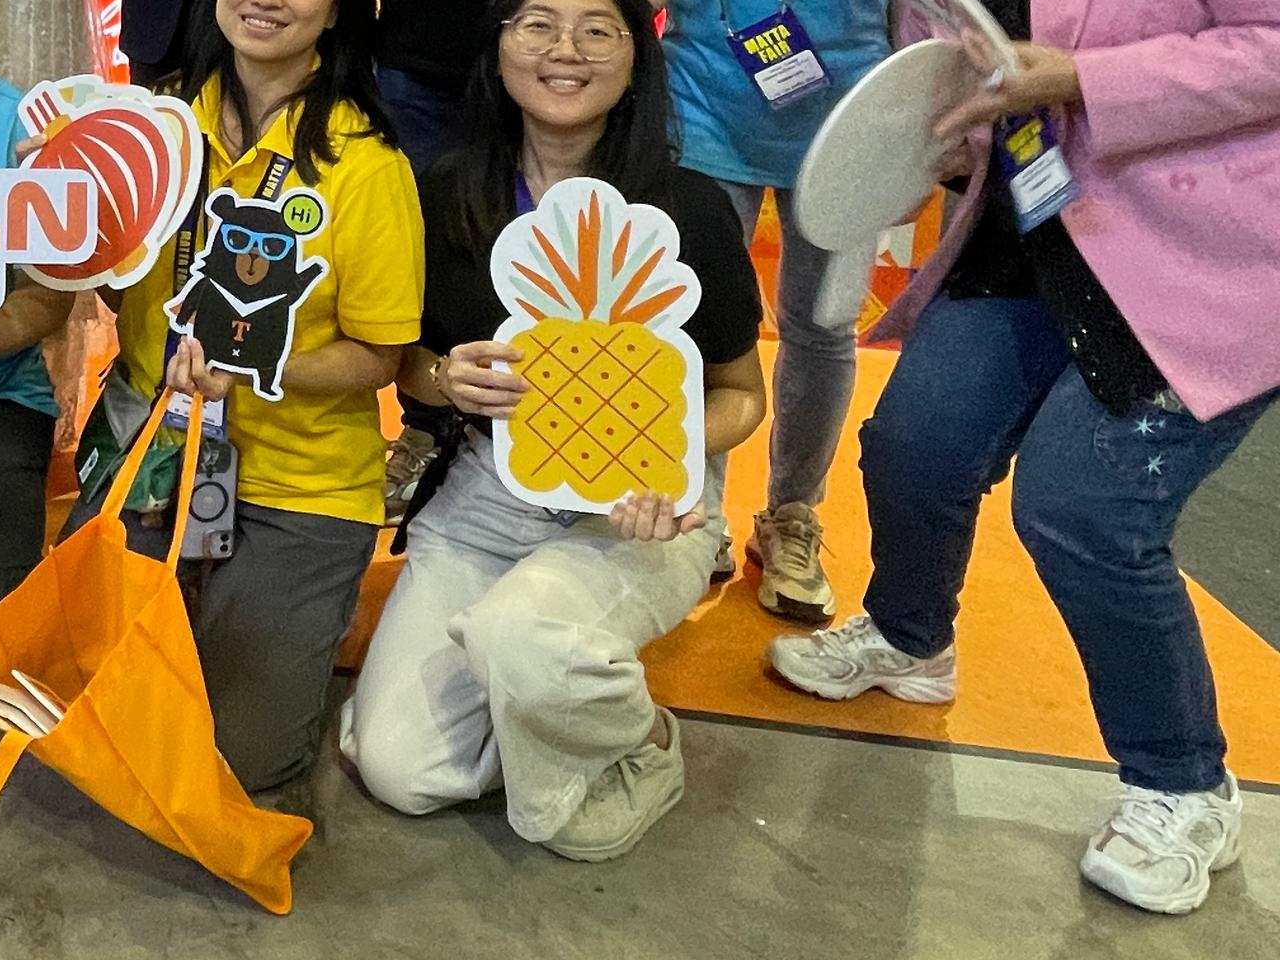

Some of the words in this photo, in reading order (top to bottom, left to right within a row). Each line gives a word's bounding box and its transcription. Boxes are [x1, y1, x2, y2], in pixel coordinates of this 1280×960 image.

[743, 24, 791, 55] MATTA
[757, 40, 791, 64] FAIR
[291, 206, 312, 224] Hi
[231, 319, 252, 342] T
